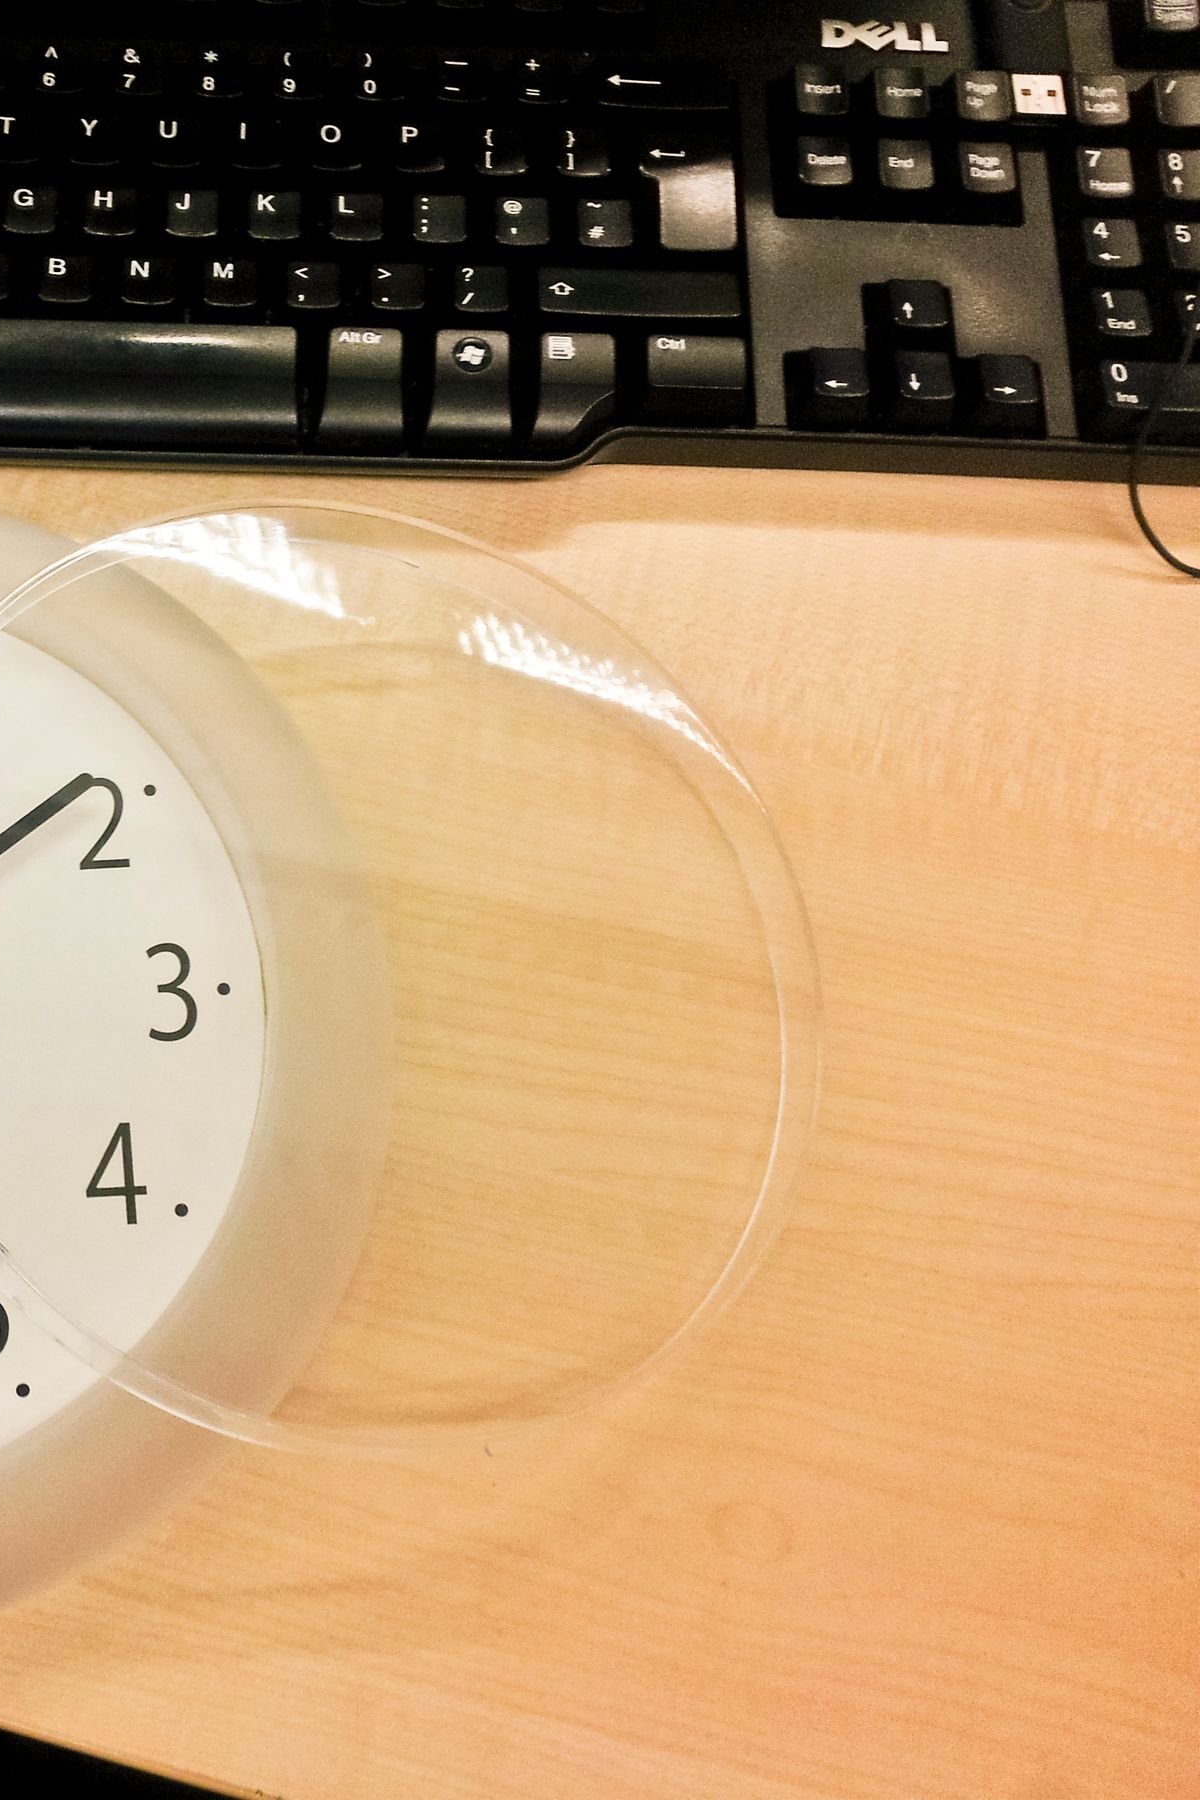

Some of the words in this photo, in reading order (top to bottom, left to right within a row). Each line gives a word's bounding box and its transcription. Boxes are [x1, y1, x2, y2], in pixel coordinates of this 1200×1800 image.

[821, 21, 949, 52] DELL
[123, 48, 141, 64] &
[42, 72, 56, 87] 6
[123, 73, 136, 88] 7
[202, 76, 215, 91] 8
[283, 78, 296, 93] 9
[363, 79, 377, 94] 0
[804, 83, 842, 95] Insert
[886, 86, 923, 97] Home
[80, 118, 98, 137] Y
[159, 120, 178, 139] U
[240, 122, 246, 140] I
[320, 124, 341, 143] O
[401, 126, 418, 143] P
[807, 153, 847, 165] Delete
[888, 156, 915, 169] End
[1085, 150, 1102, 167] 7
[1167, 152, 1184, 171] 8
[13, 188, 34, 207] G
[93, 190, 113, 208] H
[175, 193, 191, 210] J
[257, 193, 276, 212] K
[338, 195, 355, 214] L
[503, 200, 523, 215] @
[587, 225, 605, 239] #
[1093, 221, 1110, 239] 4
[1175, 224, 1192, 243] 5
[48, 257, 67, 276] B
[130, 260, 150, 278] N
[213, 262, 234, 279] M
[461, 267, 474, 282] ?
[1101, 291, 1114, 309] 1
[1107, 318, 1137, 330] End
[338, 331, 362, 345] Alt
[363, 331, 382, 345] Gr
[657, 336, 686, 351] Ctrl
[1110, 363, 1128, 382] 0
[79, 777, 131, 870] 2
[146, 942, 198, 1042] 3
[85, 1122, 148, 1225] 4
